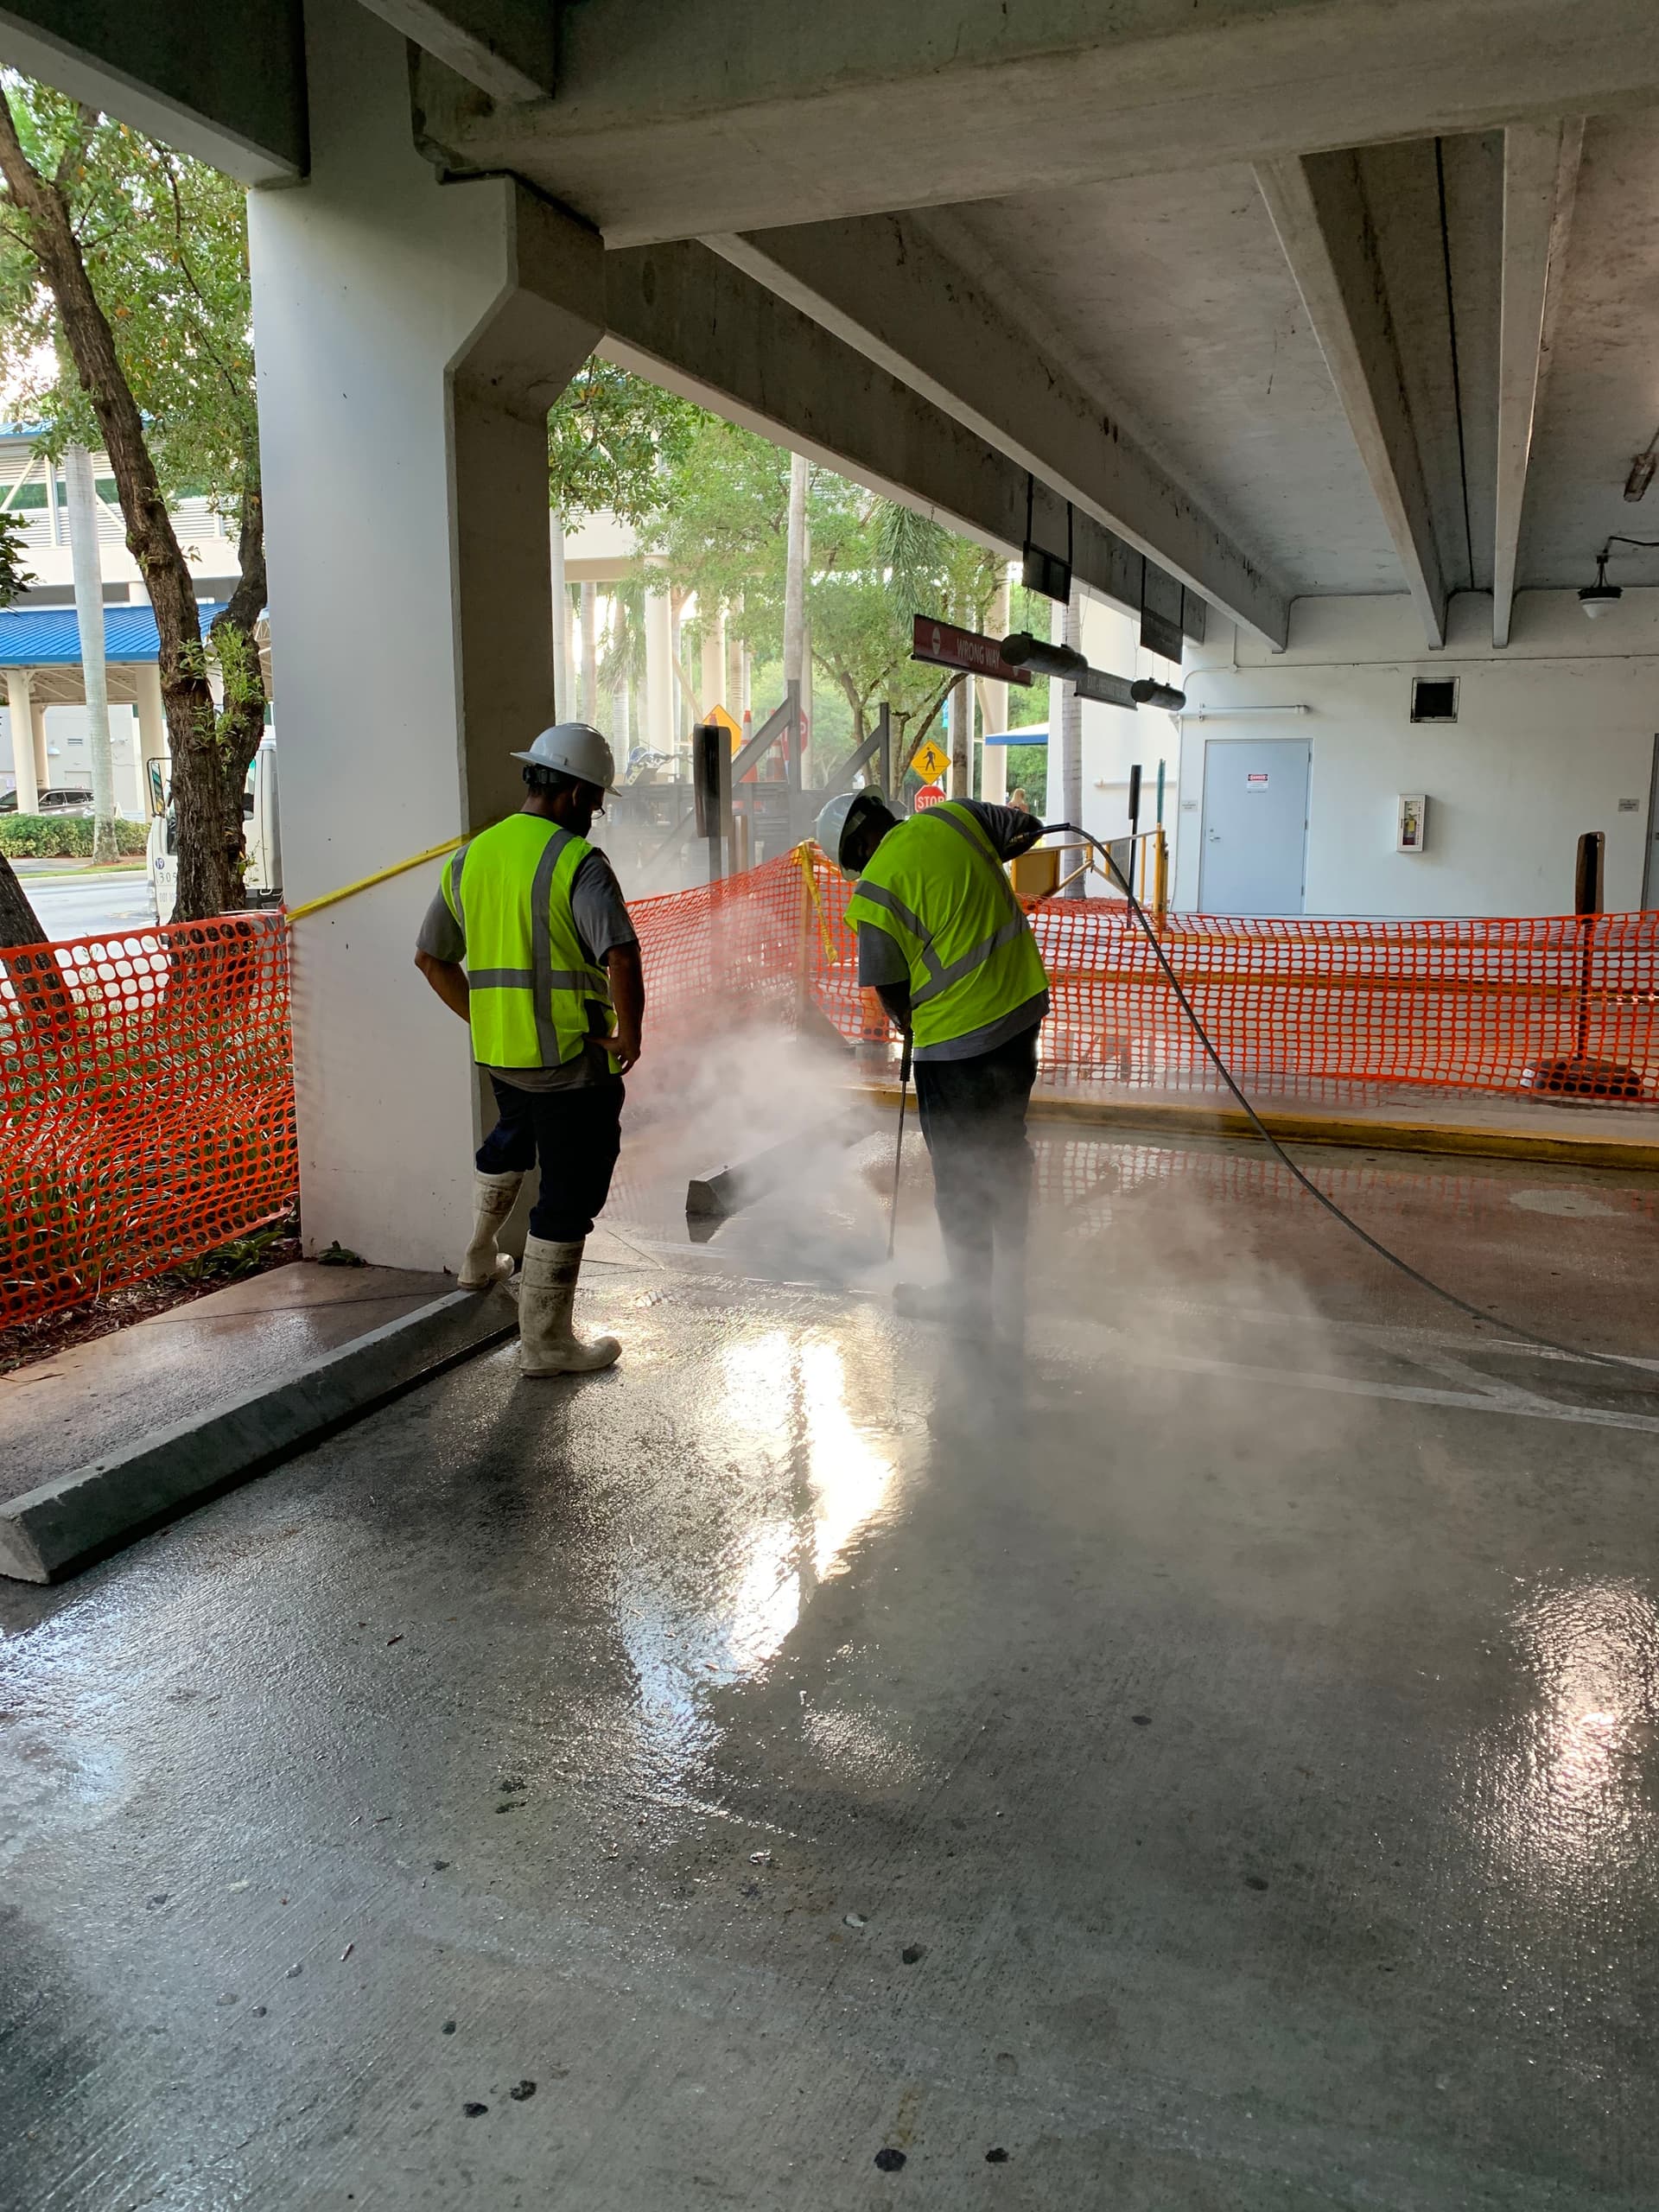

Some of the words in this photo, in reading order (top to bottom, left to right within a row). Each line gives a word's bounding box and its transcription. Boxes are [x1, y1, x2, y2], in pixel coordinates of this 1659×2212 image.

[957, 637, 984, 664] WRONG
[986, 647, 1001, 669] WAY
[156, 858, 164, 869] 19
